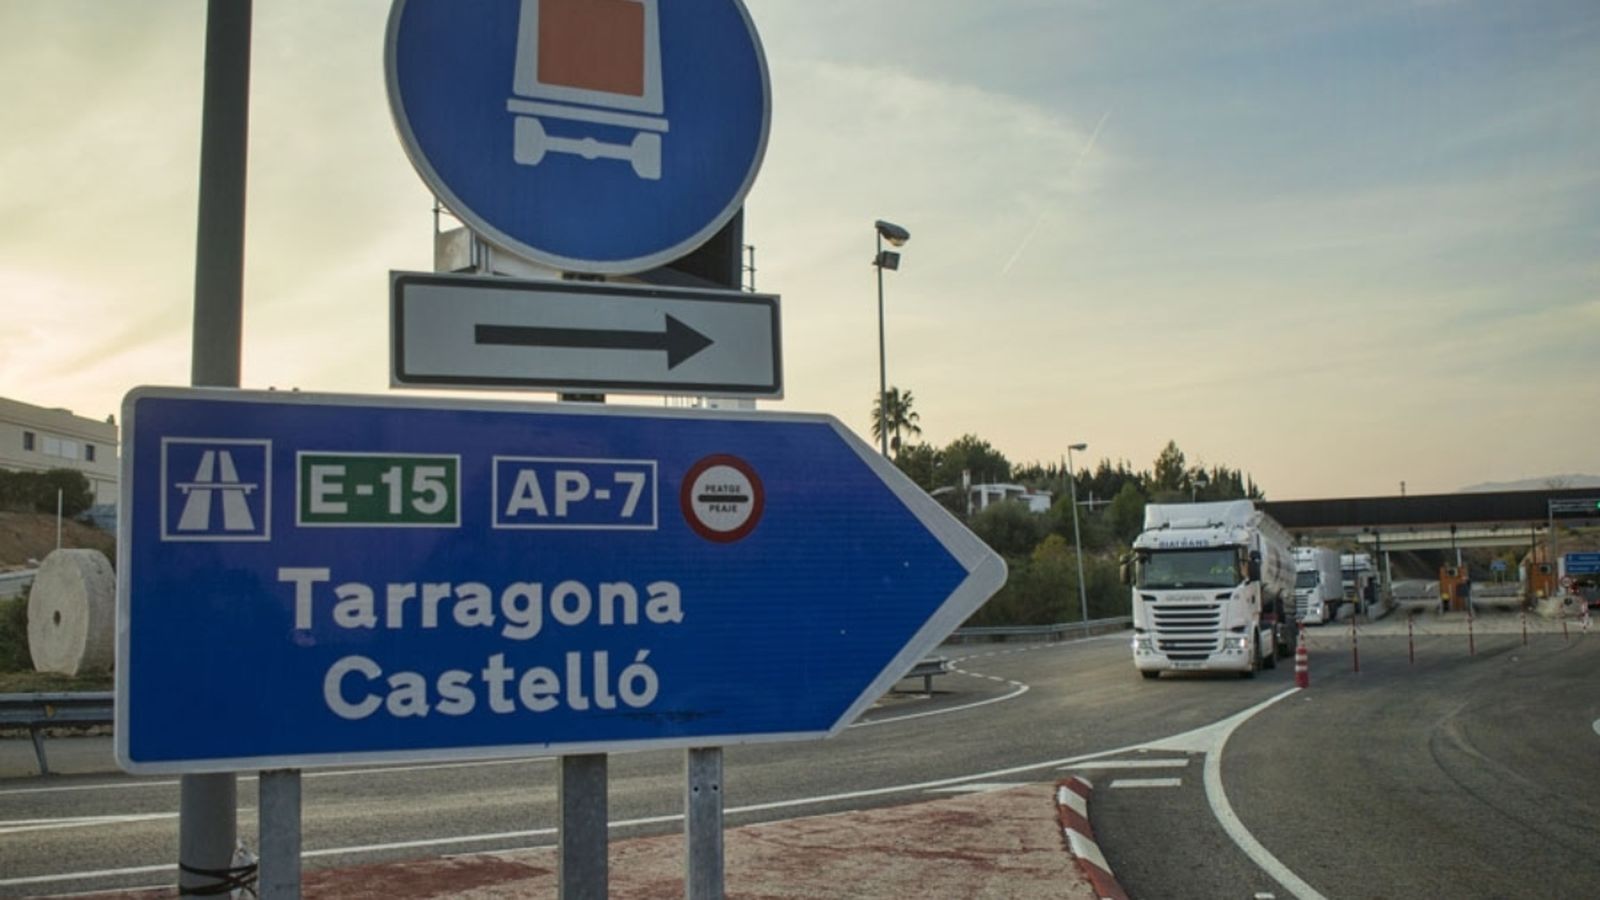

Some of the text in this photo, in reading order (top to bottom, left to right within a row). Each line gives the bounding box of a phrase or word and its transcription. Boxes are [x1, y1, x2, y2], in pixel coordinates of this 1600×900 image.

[310, 465, 447, 514] E-15
[506, 469, 646, 517] AP-7
[705, 484, 740, 493] PEATGE
[709, 504, 737, 513] PEAJE
[278, 567, 683, 640] Tarragona
[323, 649, 659, 719] Castelló
